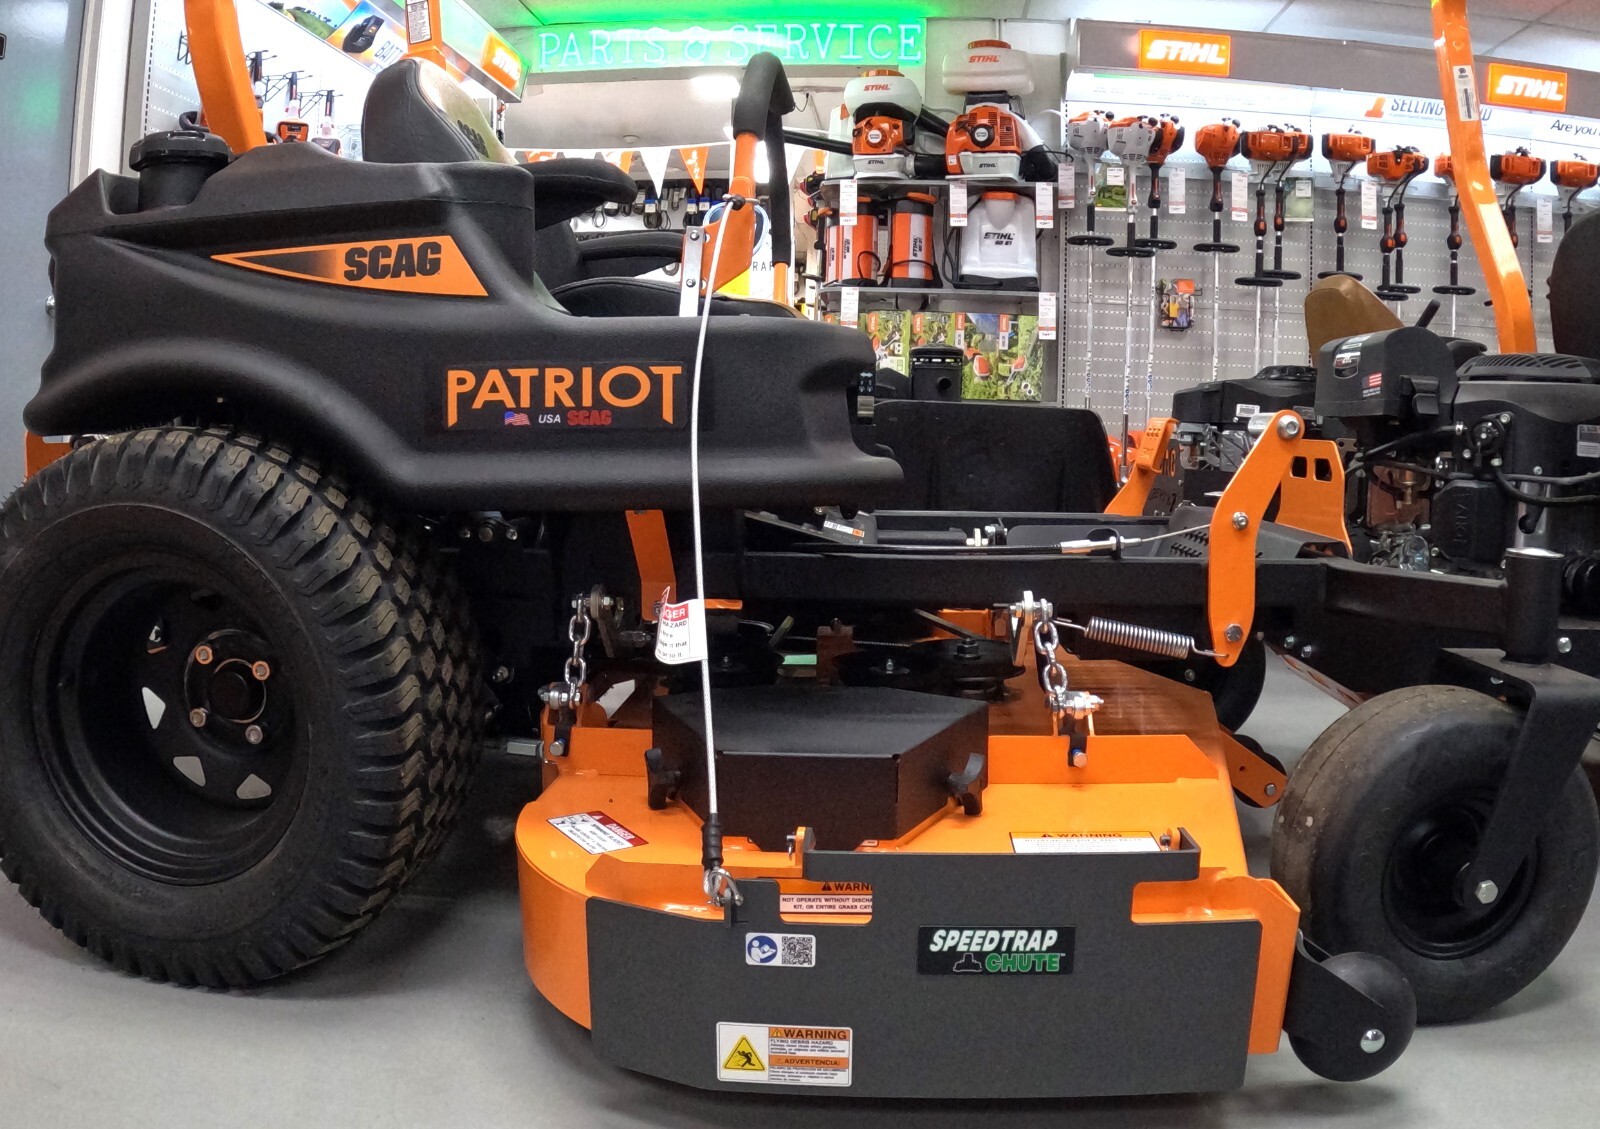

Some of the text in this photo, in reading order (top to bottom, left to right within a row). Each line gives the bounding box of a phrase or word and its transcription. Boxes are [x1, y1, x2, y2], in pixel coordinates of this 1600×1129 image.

[538, 23, 923, 69] PARTS & SERVICE
[1146, 39, 1226, 65] STIHL
[968, 54, 999, 63] STIHL
[863, 83, 890, 92] STIHL
[1496, 74, 1564, 101] STIHL
[1391, 98, 1444, 116] SELLING
[1550, 119, 1598, 136] Are you
[983, 232, 1013, 241] STIHL
[344, 241, 442, 282] SCAG
[446, 364, 683, 429] PATRIOT
[538, 409, 612, 426] USA SCAG
[665, 608, 686, 620] GER
[929, 929, 1058, 952] SPEEDTRAP
[985, 952, 1061, 973] CHUTE
[784, 1029, 847, 1040] WARNING
